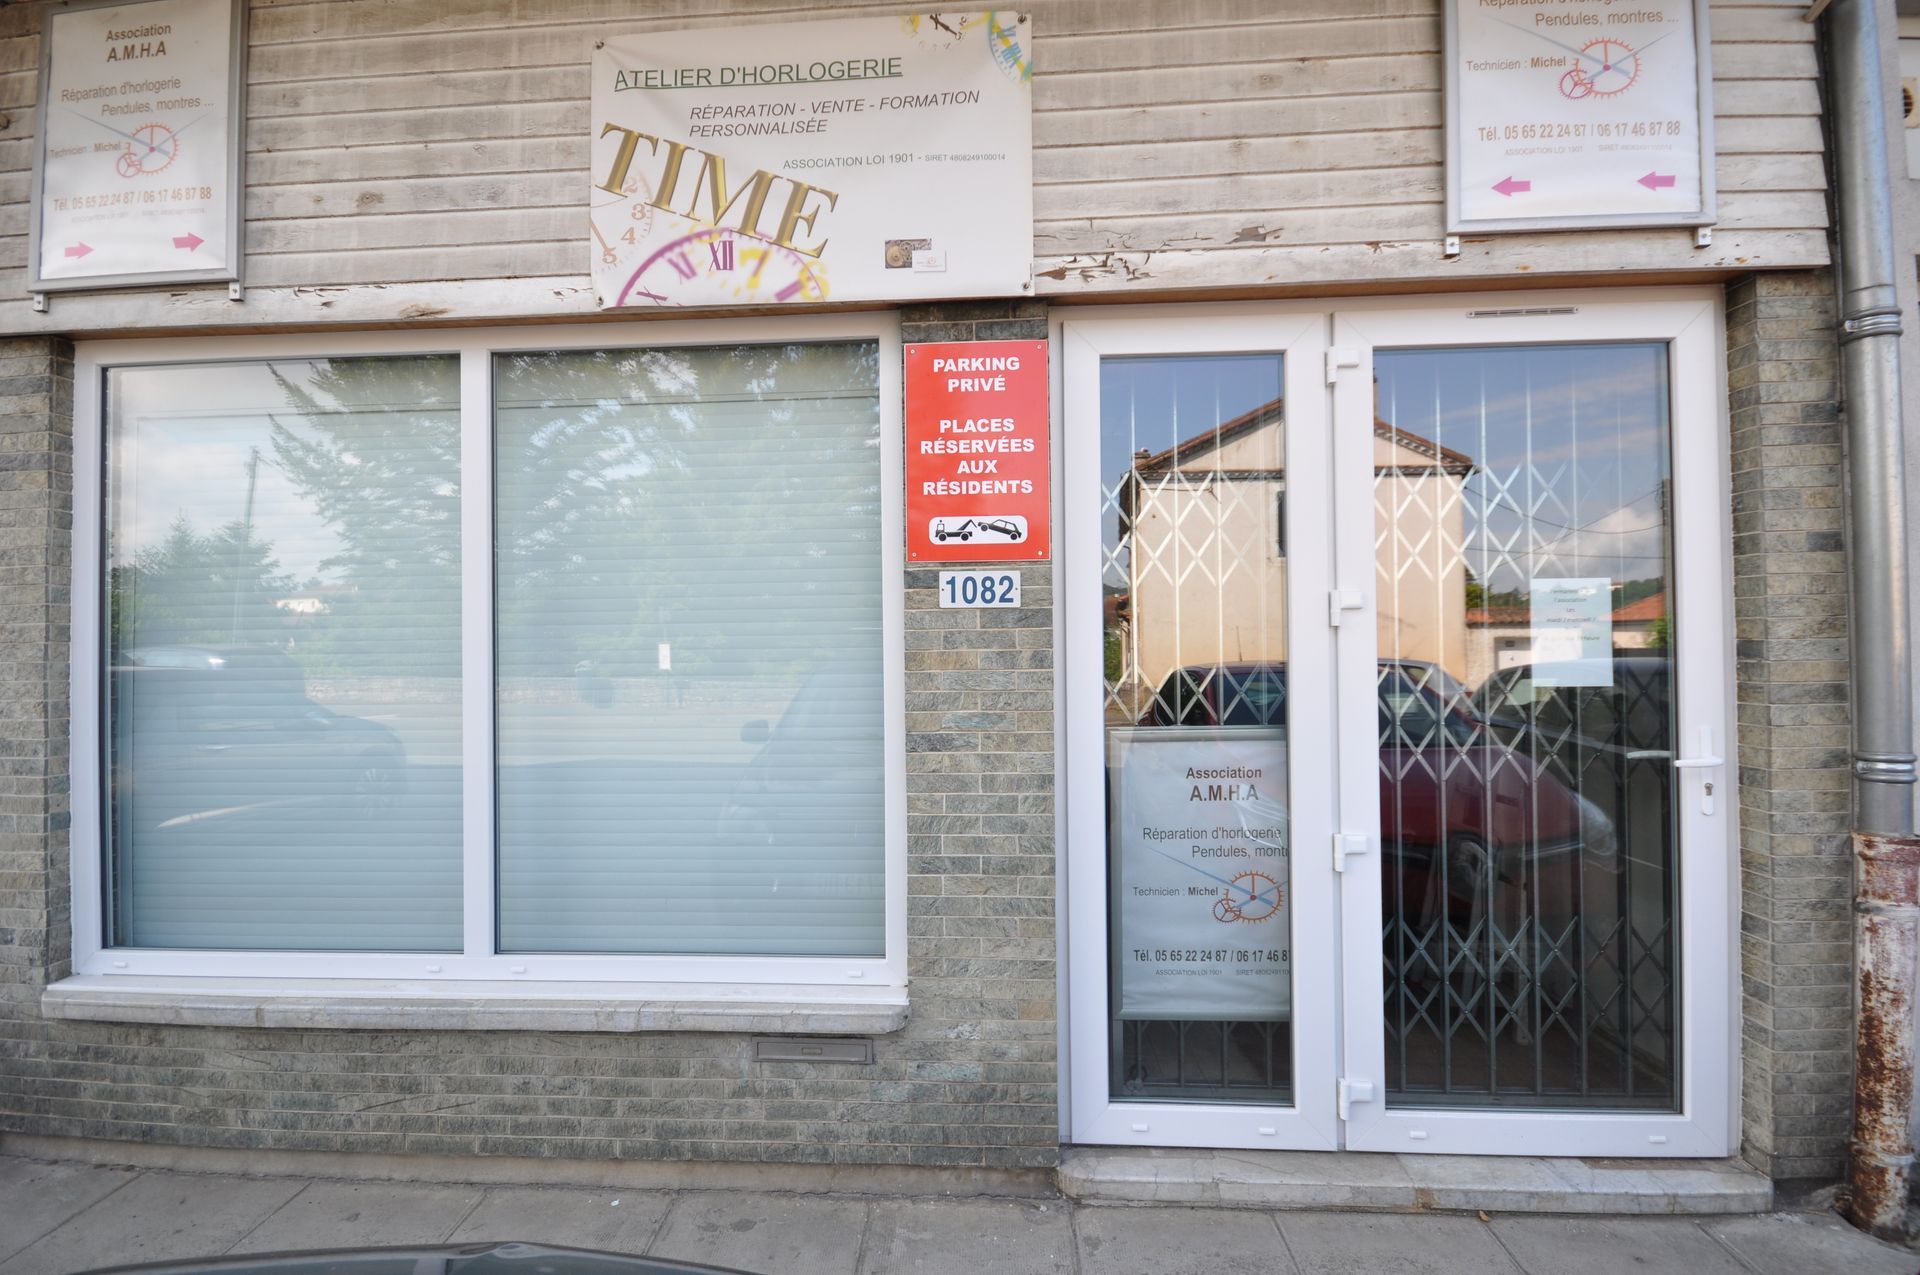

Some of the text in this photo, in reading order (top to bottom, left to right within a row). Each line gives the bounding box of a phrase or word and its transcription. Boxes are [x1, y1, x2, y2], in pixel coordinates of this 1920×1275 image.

[1535, 12, 1604, 27] Pendules,
[1607, 9, 1664, 24] montres
[106, 23, 172, 42] Association
[107, 41, 167, 63] A.M.H.A
[1467, 59, 1521, 72] Technicien
[1530, 56, 1567, 69] Michel
[615, 57, 903, 91] ATELIER D'HORLOGERIE
[61, 76, 182, 104] Réparation d'horlogerie
[101, 102, 155, 117] Pendules,
[157, 97, 201, 111] montres
[690, 103, 796, 121] RÉPARATION
[811, 98, 865, 115] VENTE
[879, 90, 980, 112] FORMATION
[689, 118, 828, 138] PERSONNALISÉE
[1478, 126, 1500, 141] Tél.
[1504, 125, 1519, 140] 05
[1522, 124, 1536, 139] 65
[1539, 124, 1553, 138] 22
[1557, 123, 1571, 138] 24
[1574, 123, 1587, 137] 87
[1597, 122, 1611, 137] 06
[1615, 122, 1629, 136] 17
[1631, 121, 1646, 136] 46
[1650, 121, 1663, 136] 87
[1666, 120, 1681, 135] 88
[94, 141, 121, 153] Michel
[783, 156, 863, 169] ASSOCIATION
[866, 155, 885, 165] LOI
[889, 153, 914, 164] 1901
[925, 154, 948, 162] SIRET
[72, 196, 84, 210] 05
[123, 191, 135, 205] 87
[143, 189, 156, 204] 06
[158, 188, 169, 202] 17
[171, 187, 183, 201] 46
[185, 187, 197, 201] 87
[199, 186, 213, 200] 88
[595, 122, 839, 259] TIME
[933, 356, 1020, 373] PARKING
[947, 374, 1006, 393] PRIVÉ
[939, 418, 1015, 434] PLACES
[920, 436, 1035, 455] RÉSERVÉES
[956, 459, 998, 474] AUX
[922, 478, 1033, 496] RÉSIDENTS
[945, 575, 1015, 605] 1082
[1186, 766, 1262, 780] Association
[1190, 784, 1259, 802] A.M.H.A
[1143, 825, 1282, 843] Réparation d'horlogerie
[1192, 845, 1251, 860] Pendules,
[1133, 886, 1181, 897] Technicien
[1188, 885, 1219, 897] Michel
[1133, 949, 1152, 963] Tél.
[1155, 950, 1168, 962] 05
[1170, 950, 1182, 962] 65
[1185, 950, 1198, 962] 22
[1200, 950, 1213, 962] 24
[1215, 950, 1227, 962] 87
[1236, 950, 1249, 962] 06
[1253, 950, 1264, 962] 17
[1267, 950, 1279, 962] 46
